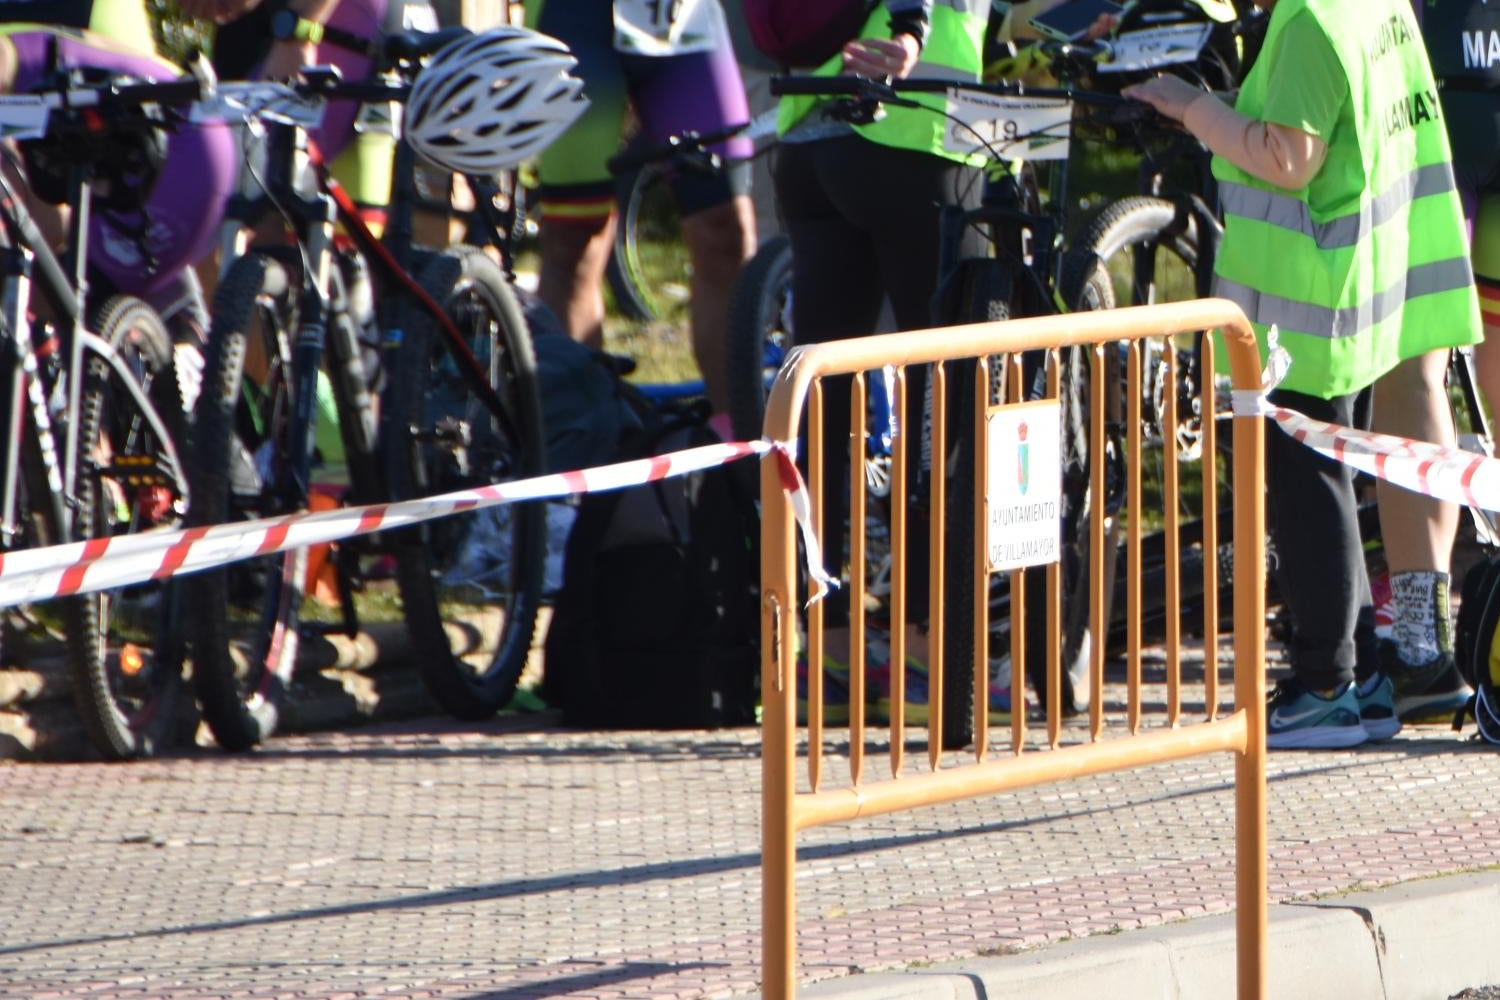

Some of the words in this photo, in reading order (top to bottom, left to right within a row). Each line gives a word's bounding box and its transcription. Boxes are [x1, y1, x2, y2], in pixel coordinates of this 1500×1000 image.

[988, 119, 1018, 142] 19
[992, 500, 1056, 528] AYUNTAMIENTO
[992, 544, 1004, 564] DE
[1005, 537, 1055, 562] VILLAMAYOR
